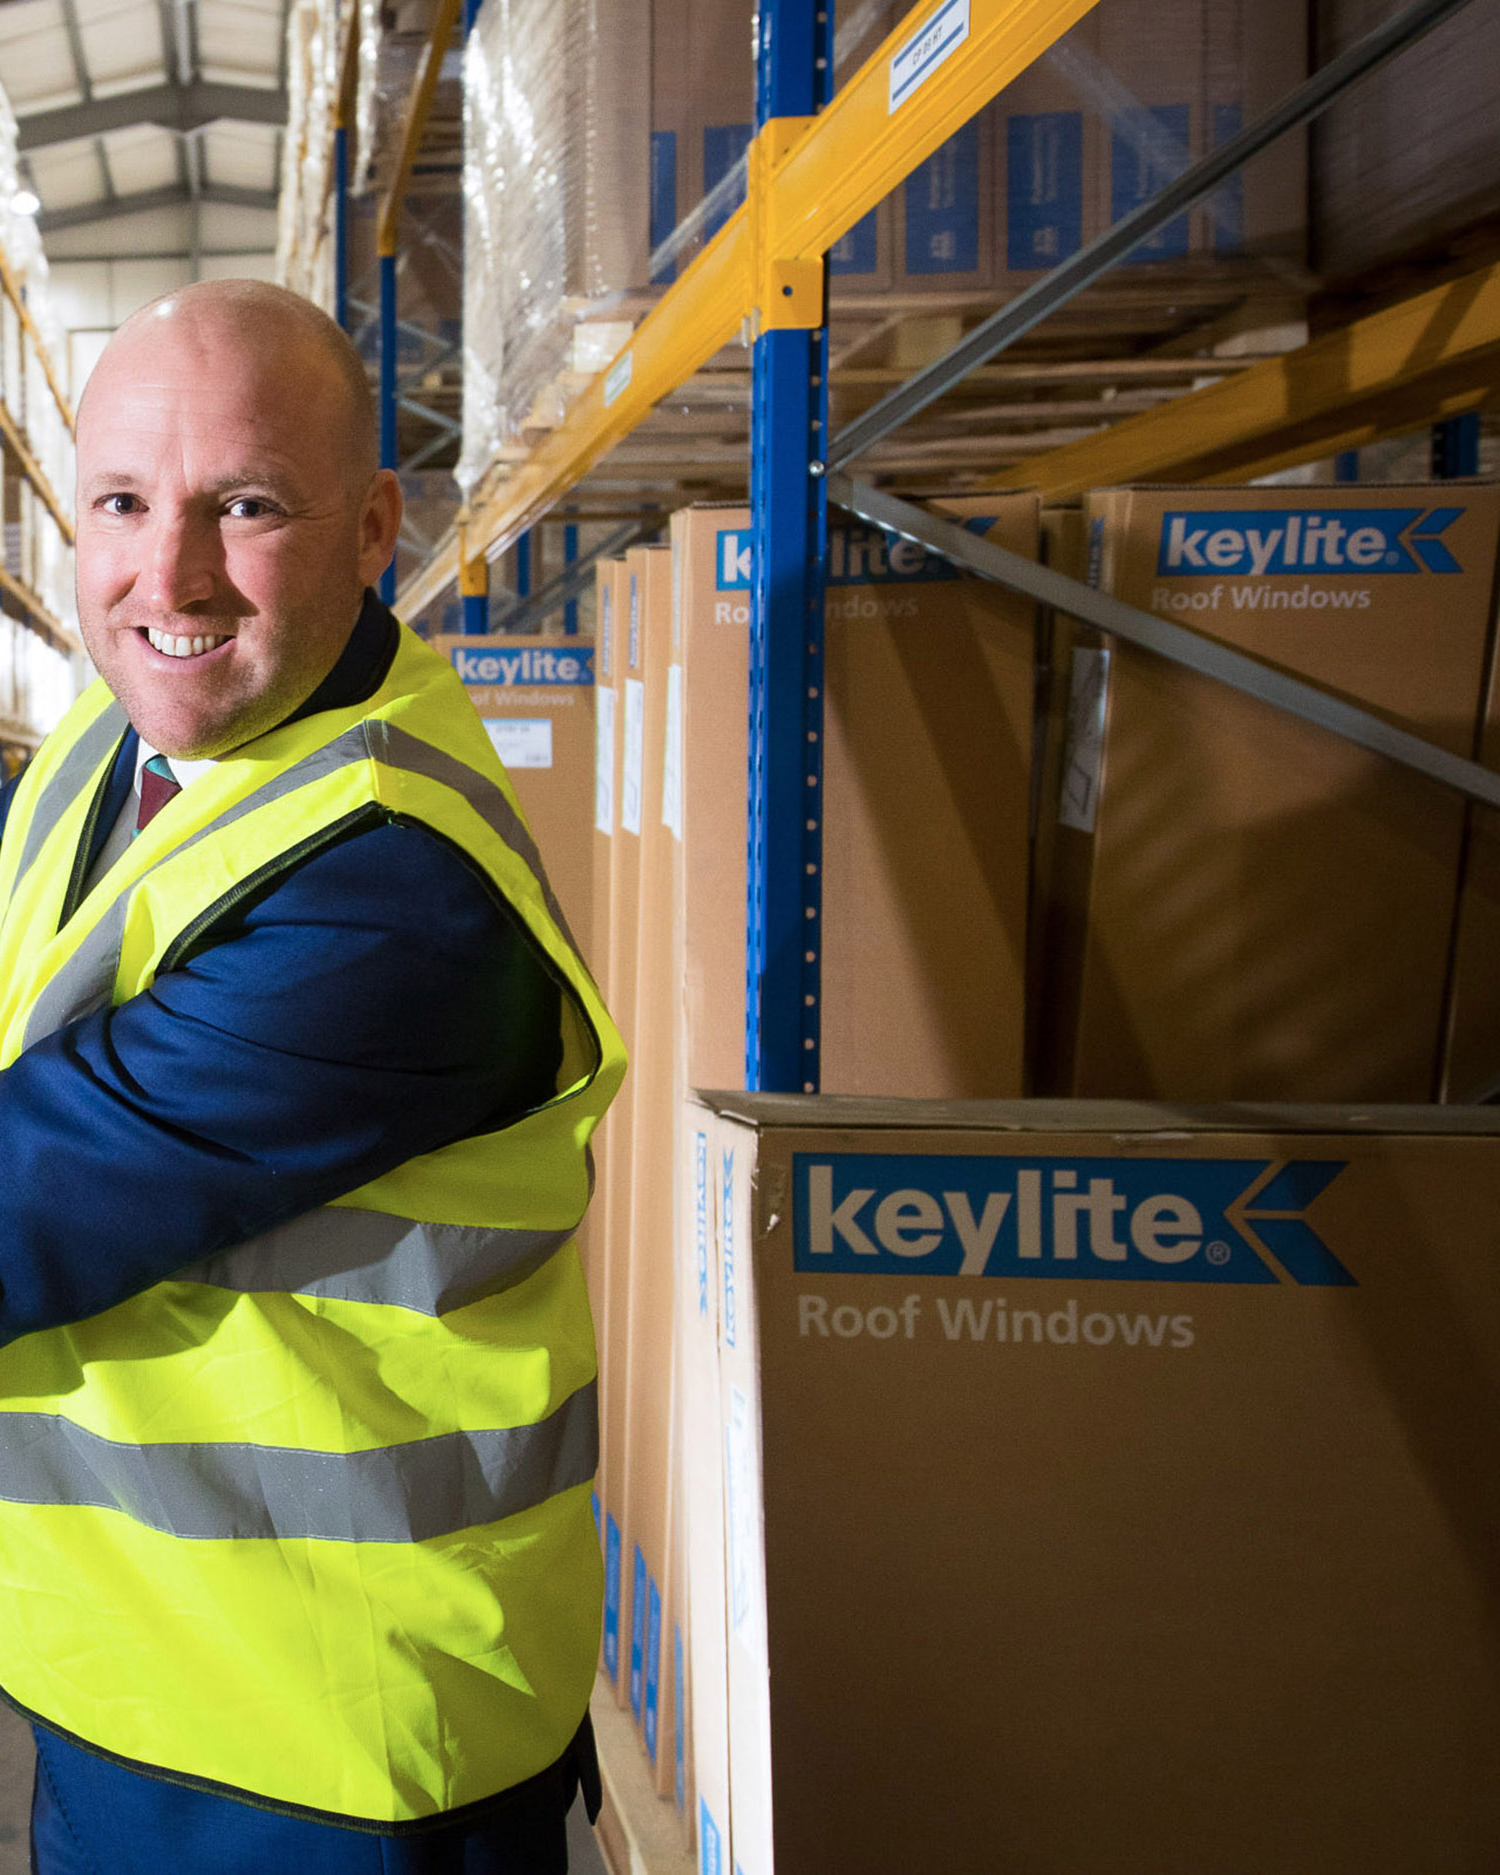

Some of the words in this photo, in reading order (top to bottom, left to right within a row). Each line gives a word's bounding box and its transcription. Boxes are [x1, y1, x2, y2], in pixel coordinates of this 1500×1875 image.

[1152, 584, 1224, 610] Roof
[1231, 583, 1371, 609] Windows
[715, 601, 749, 625] Ro
[495, 689, 575, 706] Windows
[799, 1294, 922, 1340] Roof
[936, 1298, 1195, 1348] Windows
